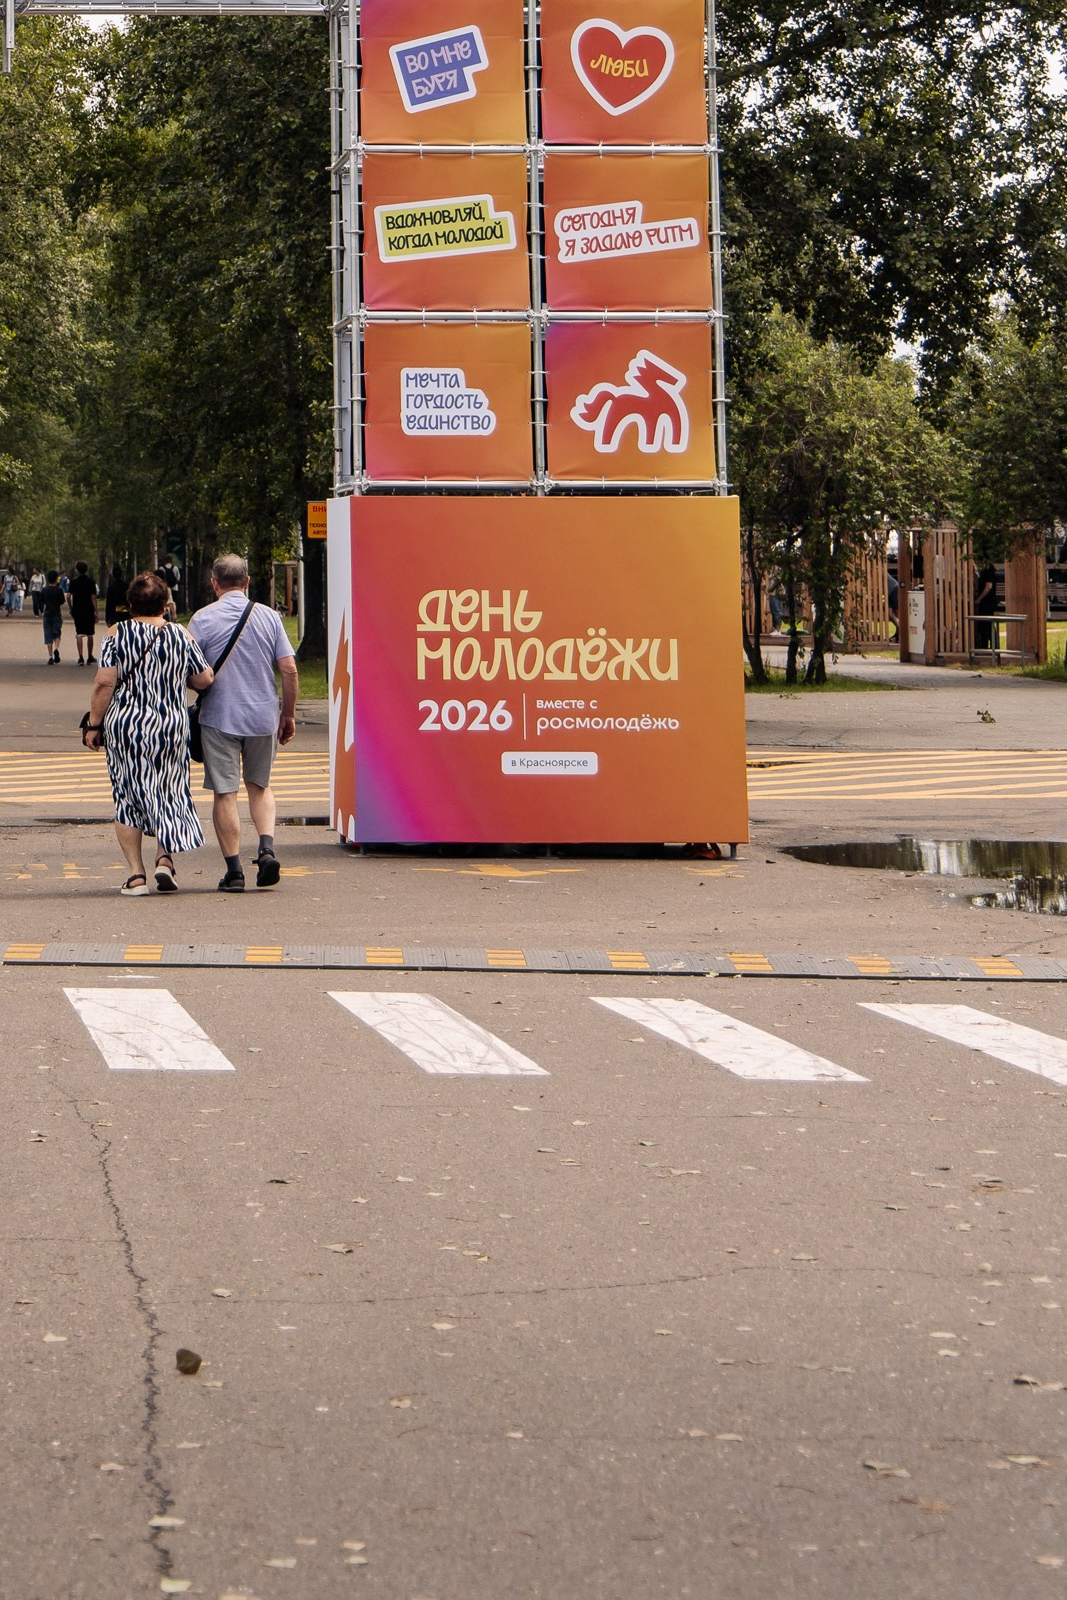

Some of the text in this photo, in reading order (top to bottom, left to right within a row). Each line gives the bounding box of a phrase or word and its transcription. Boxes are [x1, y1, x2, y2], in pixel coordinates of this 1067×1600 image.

[404, 39, 472, 74] ВО МНЕ
[590, 53, 650, 79] ЛЮБИ
[411, 69, 459, 99] БУРЯ
[385, 202, 486, 230] ВДОХНОВЛЯЙ,
[560, 206, 636, 233] СЕГОДНЯ
[388, 220, 504, 251] КОГДА МОЛОДОЙ
[564, 223, 695, 257] Я ЗАДАЮ РИТМ
[405, 372, 460, 389] МЕЧТА
[405, 393, 484, 410] ГОРДОСТЬ
[405, 414, 492, 431] ЕДИНСТВО
[418, 699, 513, 731] 2026
[536, 699, 598, 709] вместе с
[536, 713, 680, 736] росмолодёжь
[511, 757, 588, 769] в Красноярске
